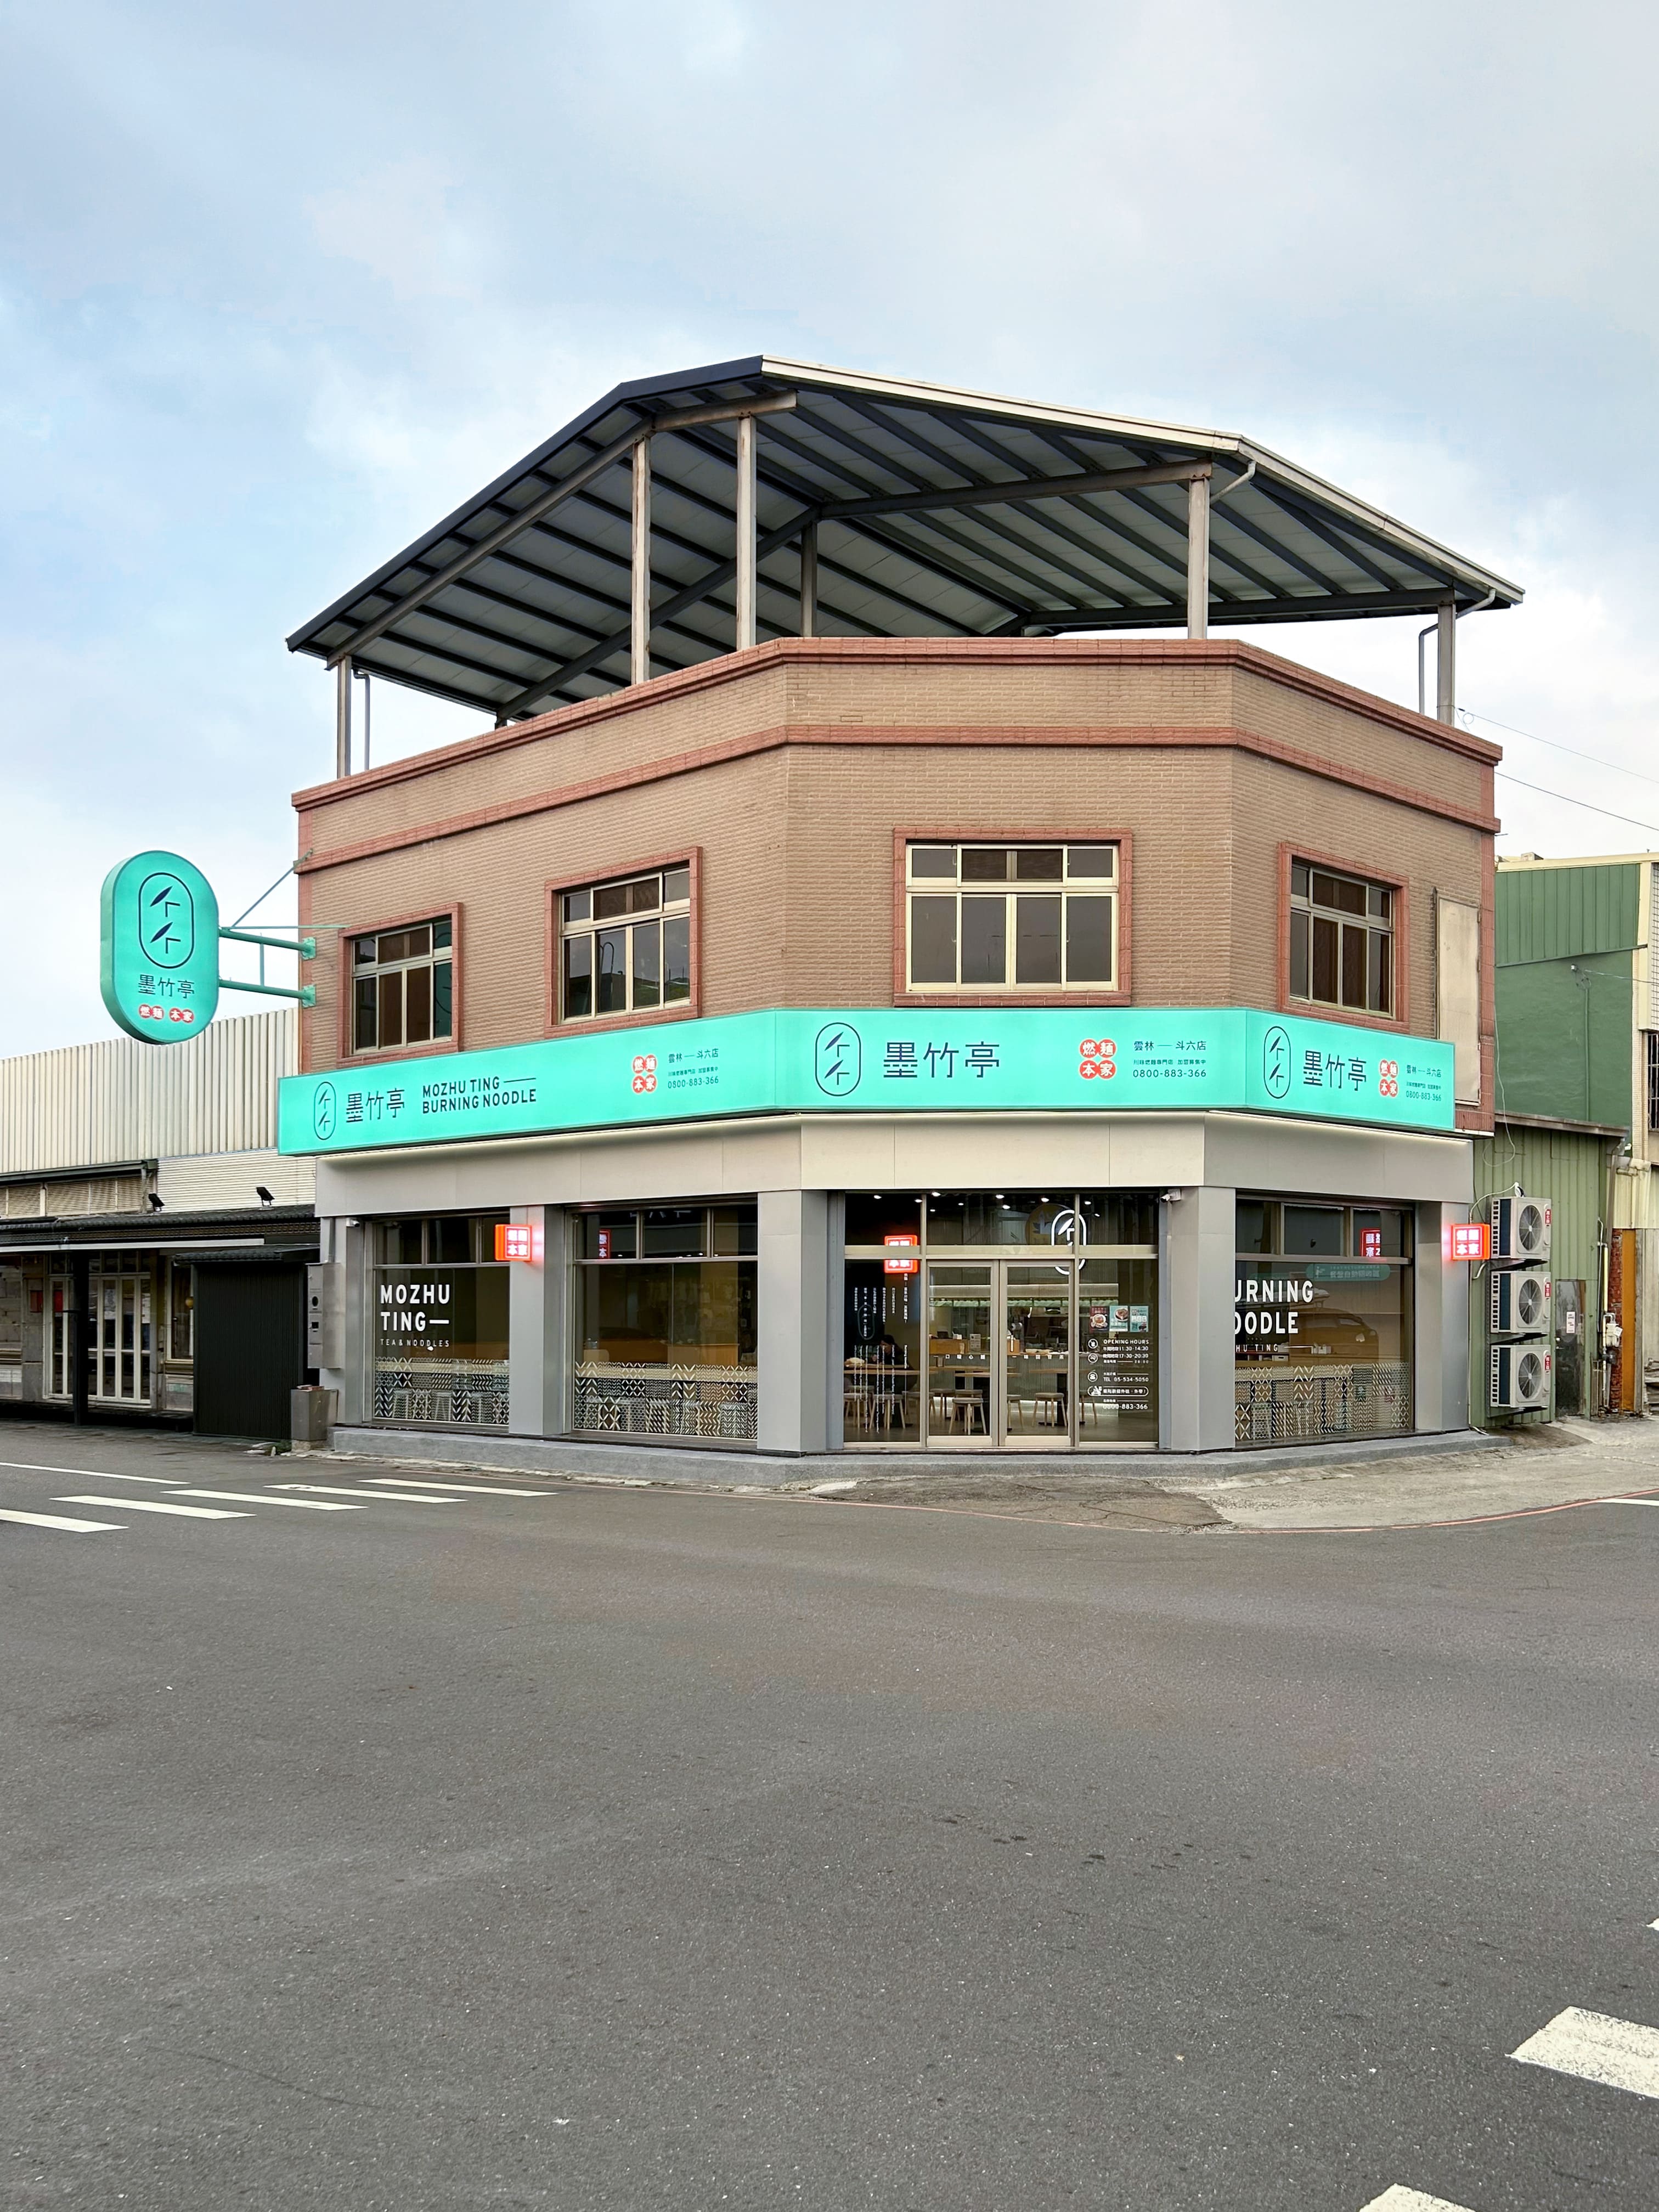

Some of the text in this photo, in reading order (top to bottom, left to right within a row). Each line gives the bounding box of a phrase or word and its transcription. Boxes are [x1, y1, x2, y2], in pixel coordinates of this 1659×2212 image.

[138, 974, 195, 998] 墨竹亭
[696, 1048, 719, 1059] 斗六店
[1082, 1042, 1114, 1056] 燃麵
[1133, 1040, 1206, 1051] 雲林 斗六店
[883, 1041, 1000, 1078] 墨竹亭
[1082, 1063, 1113, 1076] 本家
[1133, 1069, 1206, 1077] 0800-883-366
[1303, 1050, 1367, 1091] 墨竹亭
[422, 1076, 500, 1098] MOZHU TING
[668, 1076, 719, 1089] 0800-883-366
[346, 1087, 405, 1123] 墨竹亭
[422, 1089, 537, 1114] BURNING NOODLE
[380, 1284, 450, 1304] MOZHU
[380, 1312, 426, 1331] TING
[407, 1339, 449, 1347] NOODLES
[1255, 1344, 1278, 1352] TING
